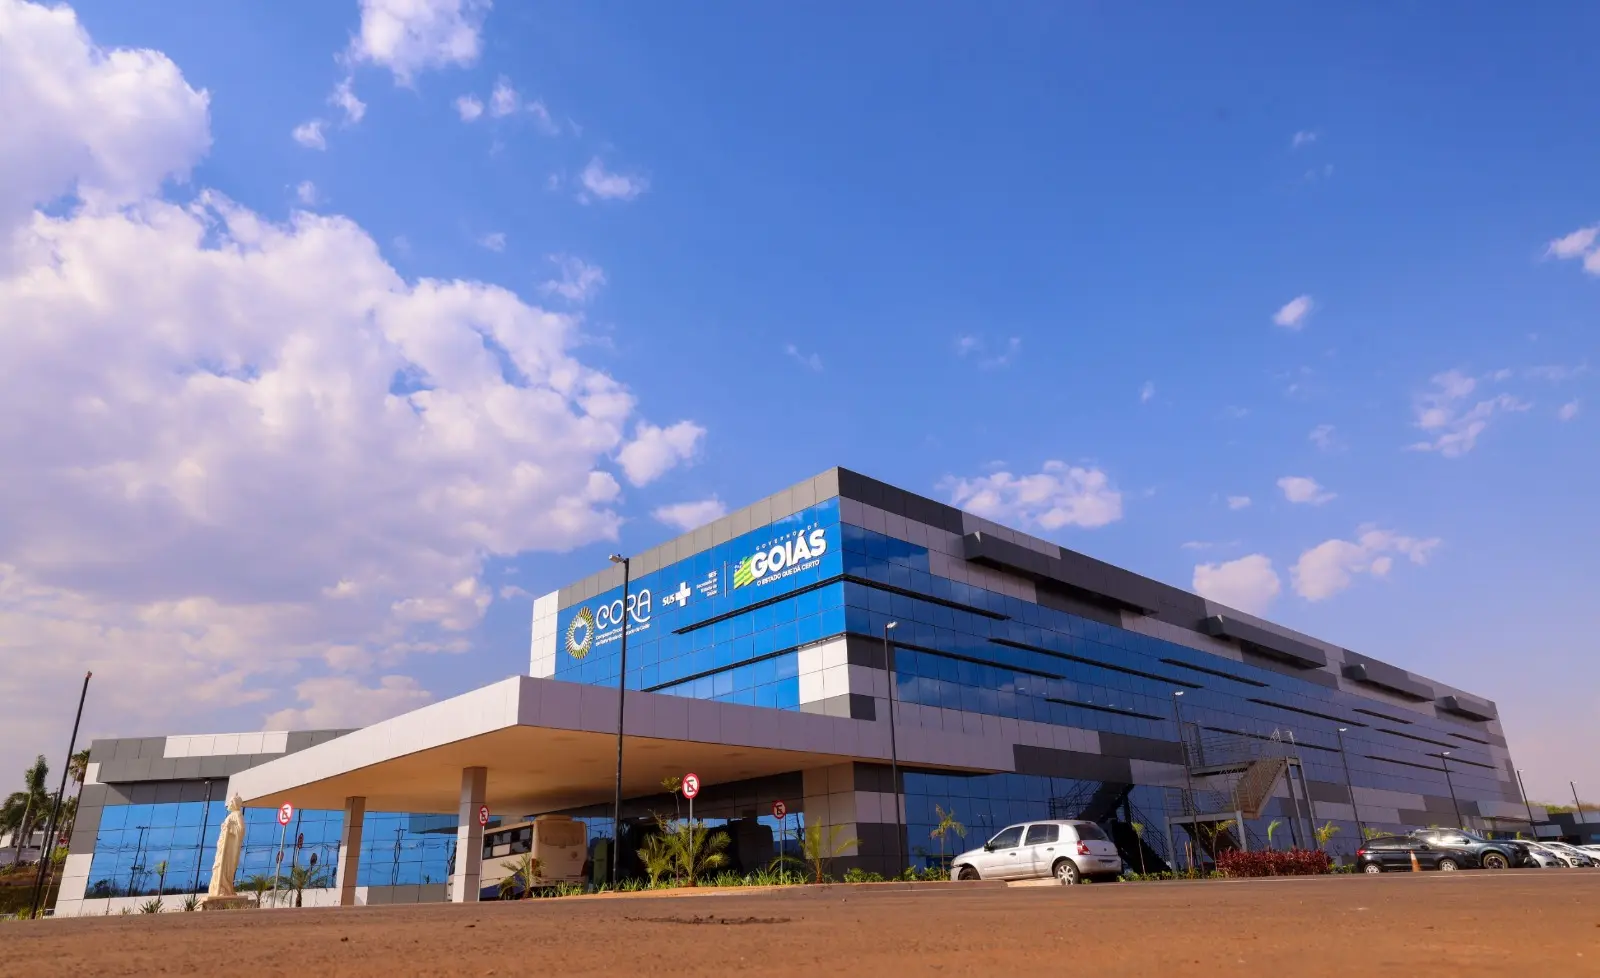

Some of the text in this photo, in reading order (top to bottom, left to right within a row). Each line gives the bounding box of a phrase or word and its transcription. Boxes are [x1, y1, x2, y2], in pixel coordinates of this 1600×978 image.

[755, 522, 818, 551] GOVERNO DE
[750, 529, 827, 579] GOIÁS
[762, 572, 782, 585] ESTADO
[782, 569, 793, 577] QUE
[801, 560, 819, 570] CERTO
[596, 589, 651, 629] CORA
[662, 593, 676, 607] SUS
